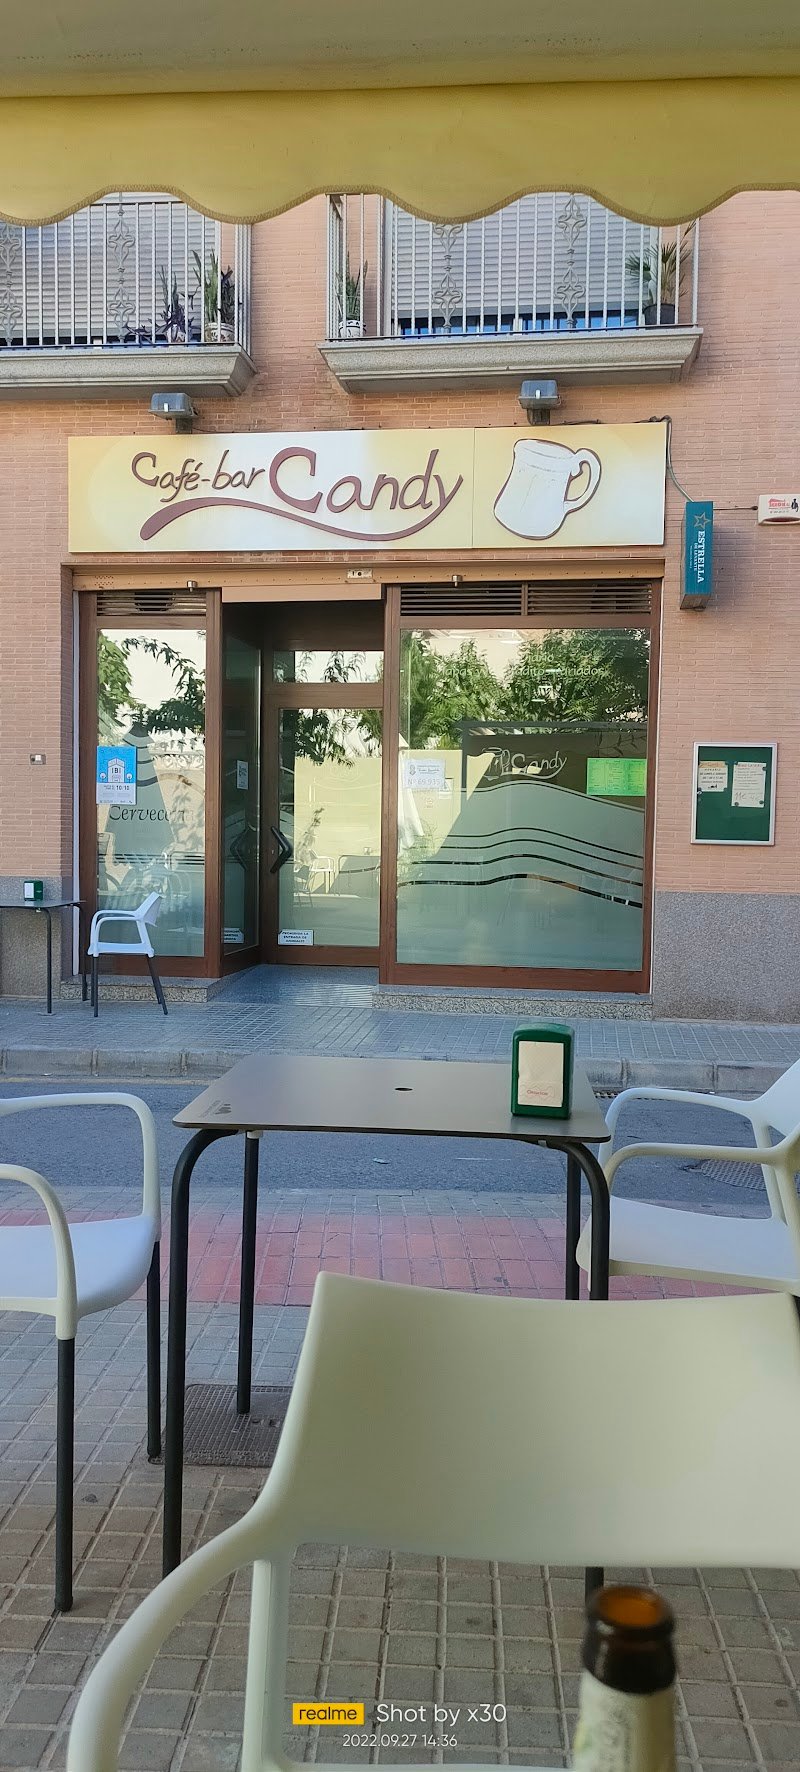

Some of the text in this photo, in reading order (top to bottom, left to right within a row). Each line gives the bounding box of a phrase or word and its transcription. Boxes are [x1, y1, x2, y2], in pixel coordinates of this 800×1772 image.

[131, 446, 463, 520] Café-bar Candy
[697, 530, 705, 583] ESTRELLA
[511, 751, 567, 773] Candy
